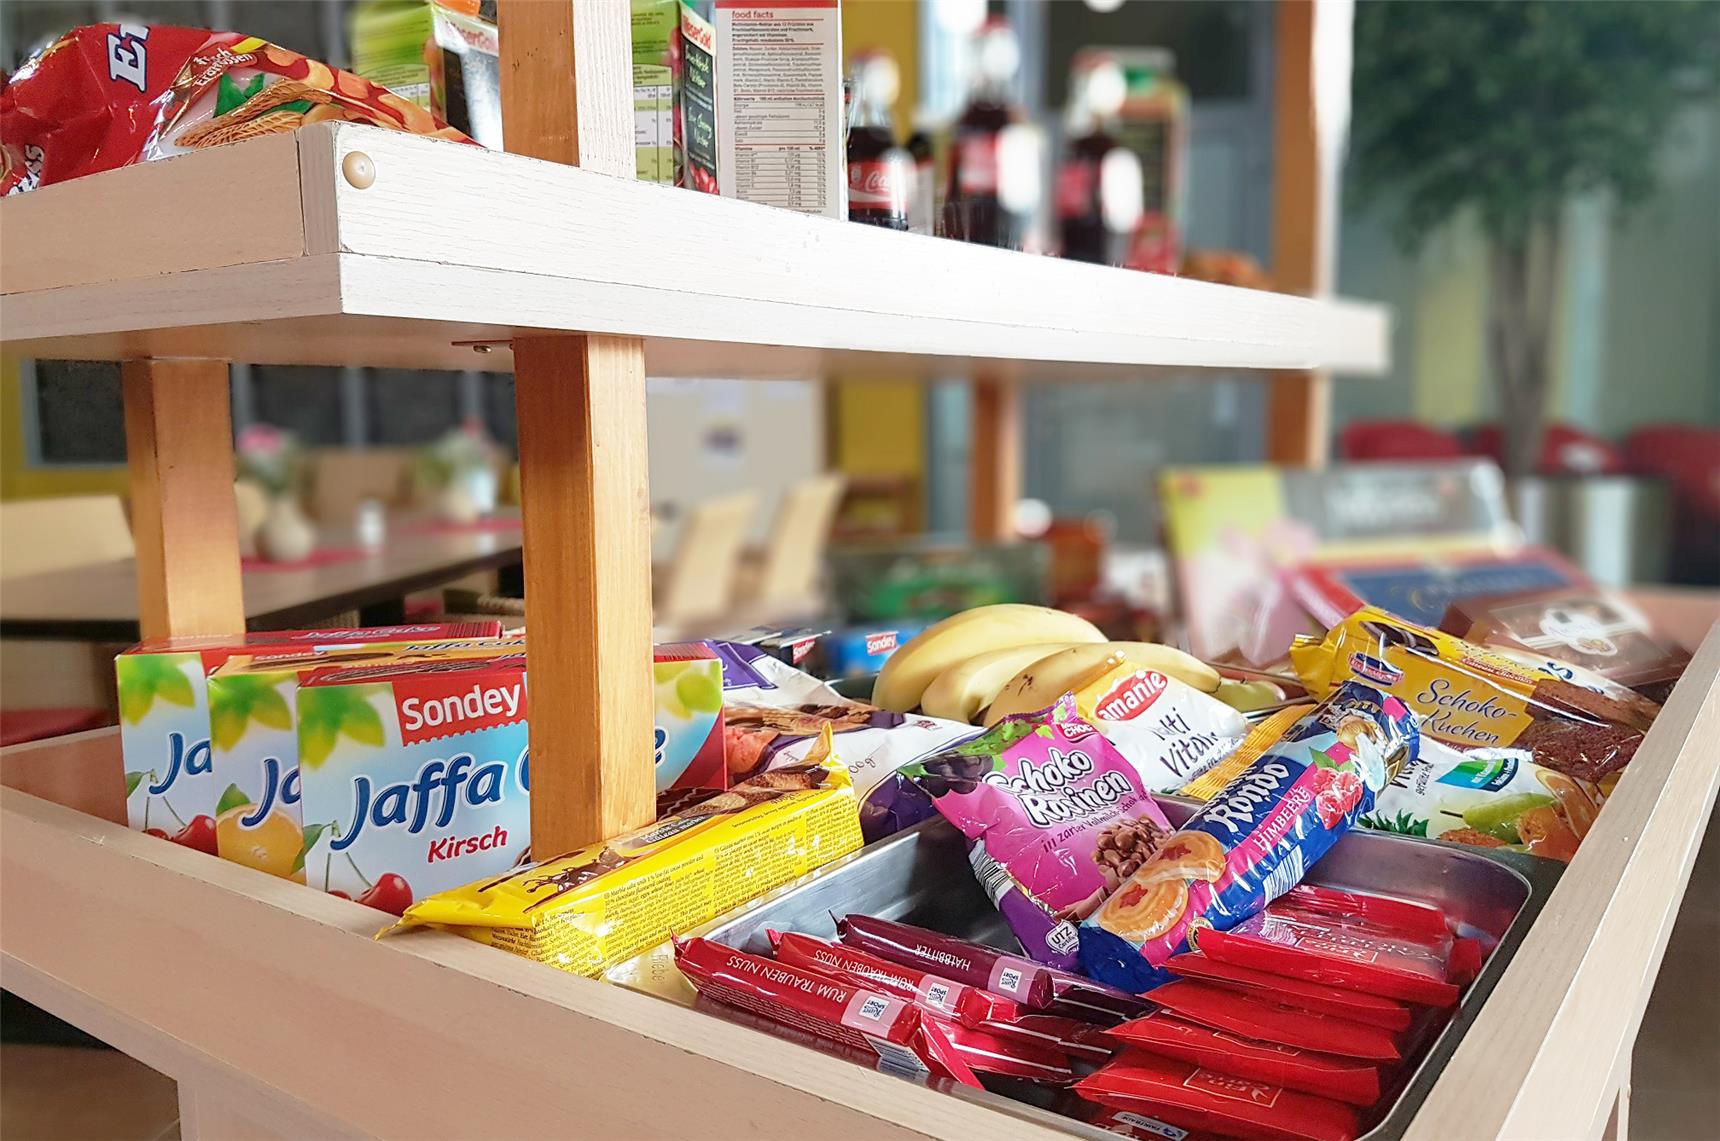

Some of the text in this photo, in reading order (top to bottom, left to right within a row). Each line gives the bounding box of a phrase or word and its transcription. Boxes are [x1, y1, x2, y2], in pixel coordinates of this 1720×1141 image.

[731, 10, 774, 19] food facts
[866, 638, 896, 654] Sondey
[402, 684, 521, 731] Sondey
[1098, 672, 1166, 720] amanie
[1416, 679, 1518, 718] Schoko-
[1421, 708, 1501, 745] Kuchen
[984, 749, 1092, 795] Schoko
[330, 755, 505, 851] Jaffa
[1019, 771, 1133, 827] Rosinen
[1204, 763, 1290, 833] Rondo
[1057, 822, 1086, 842] zarter
[1252, 784, 1312, 852] HIMBEERE
[427, 825, 508, 864] Kirsch
[1051, 926, 1073, 945] UTZ
[813, 949, 842, 966] NUSS
[842, 959, 891, 983] TRAUBEN
[915, 943, 972, 971] HALBBITTER
[725, 954, 847, 1003] RUM TRAUBEN NUSS
[866, 999, 886, 1010] SPORT
